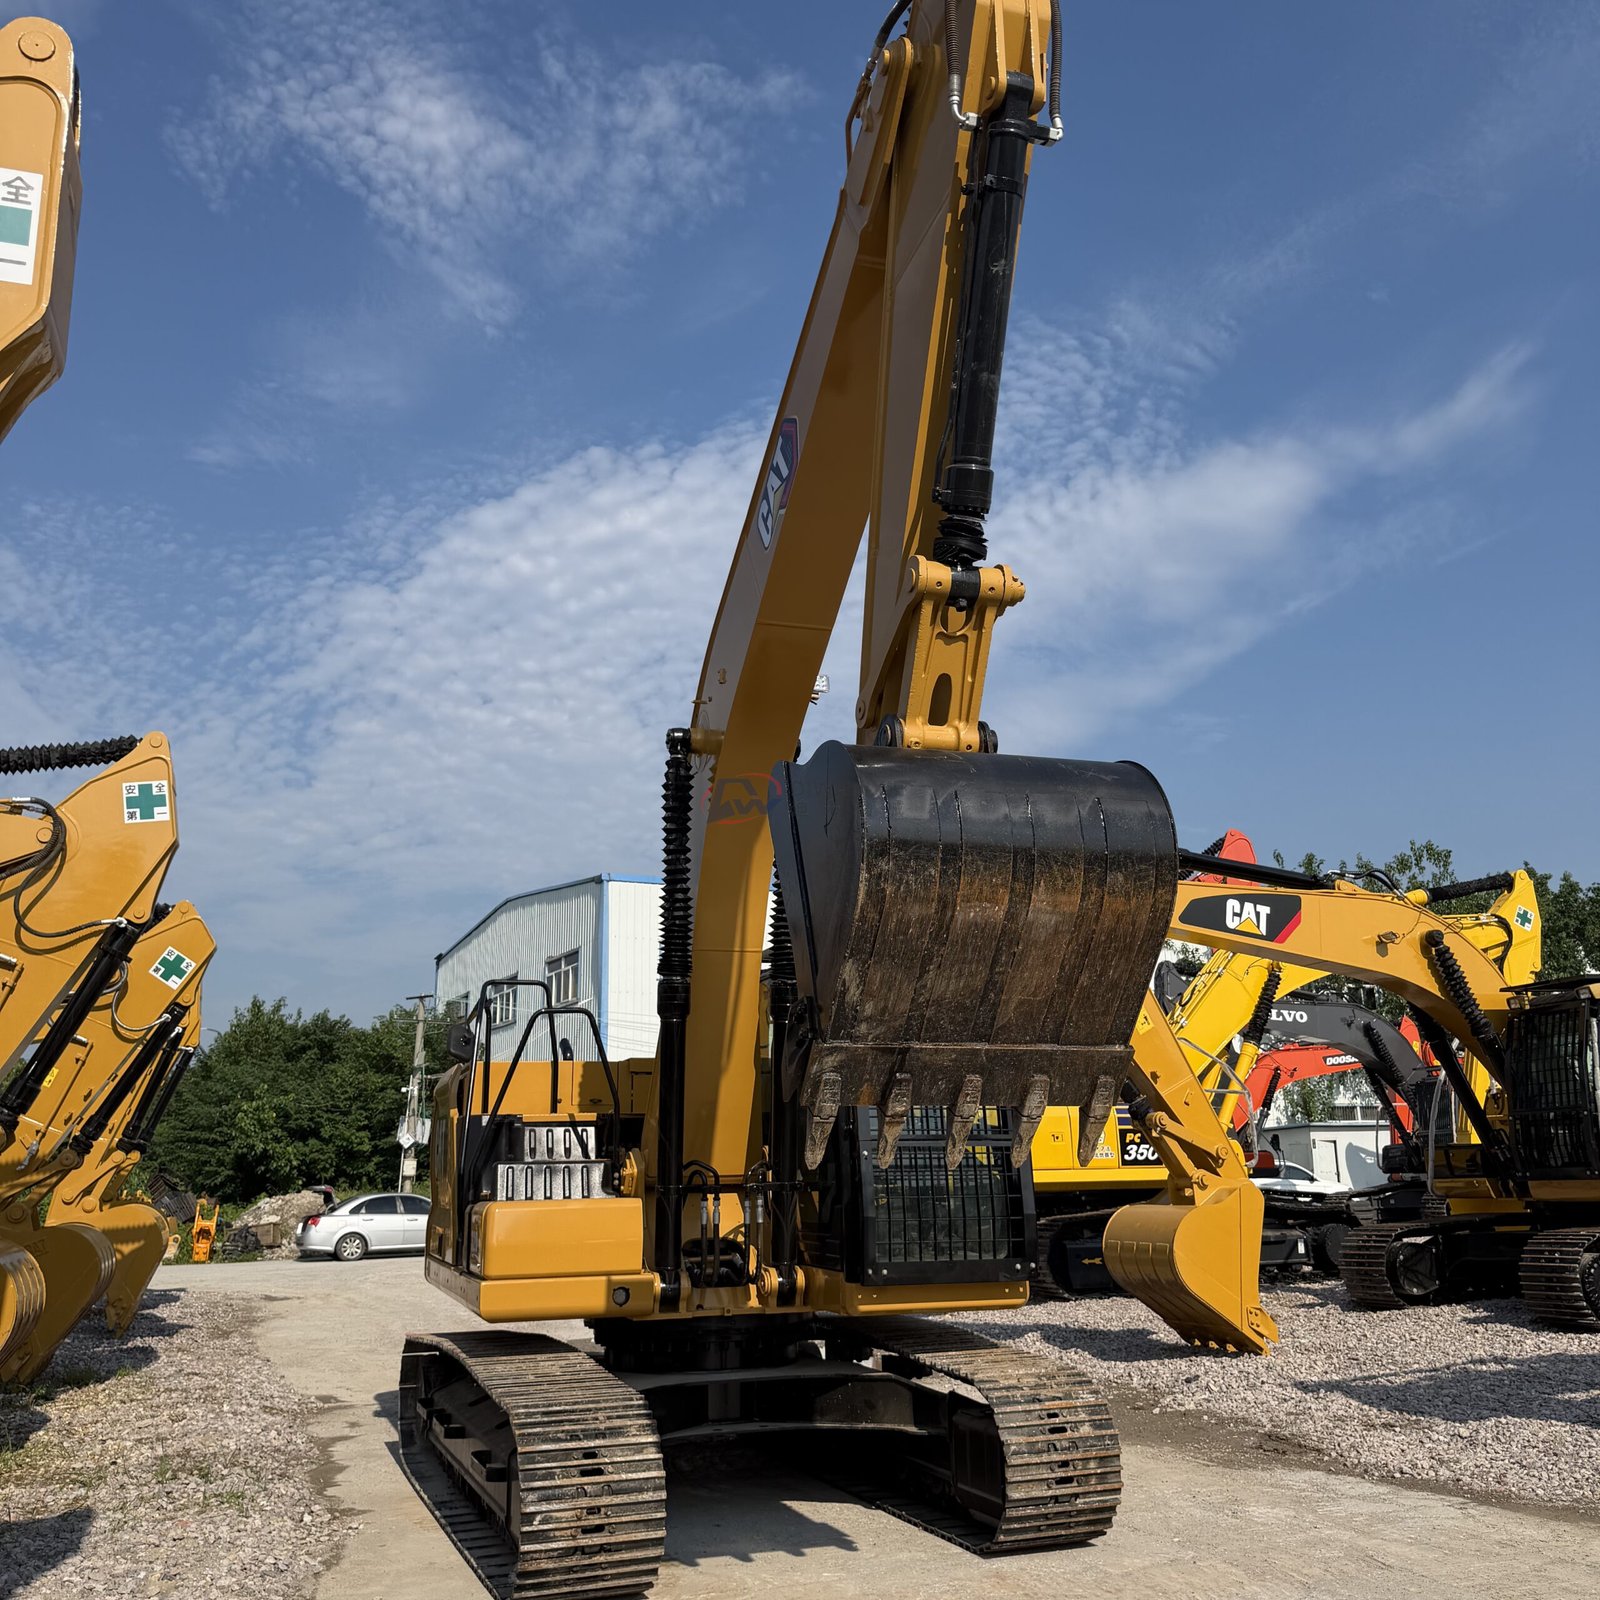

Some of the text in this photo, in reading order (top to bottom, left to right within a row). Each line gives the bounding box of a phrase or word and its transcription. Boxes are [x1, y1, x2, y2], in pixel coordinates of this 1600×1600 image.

[1, 176, 34, 205] 全
[758, 435, 789, 549] CAT
[1226, 898, 1271, 936] CAT
